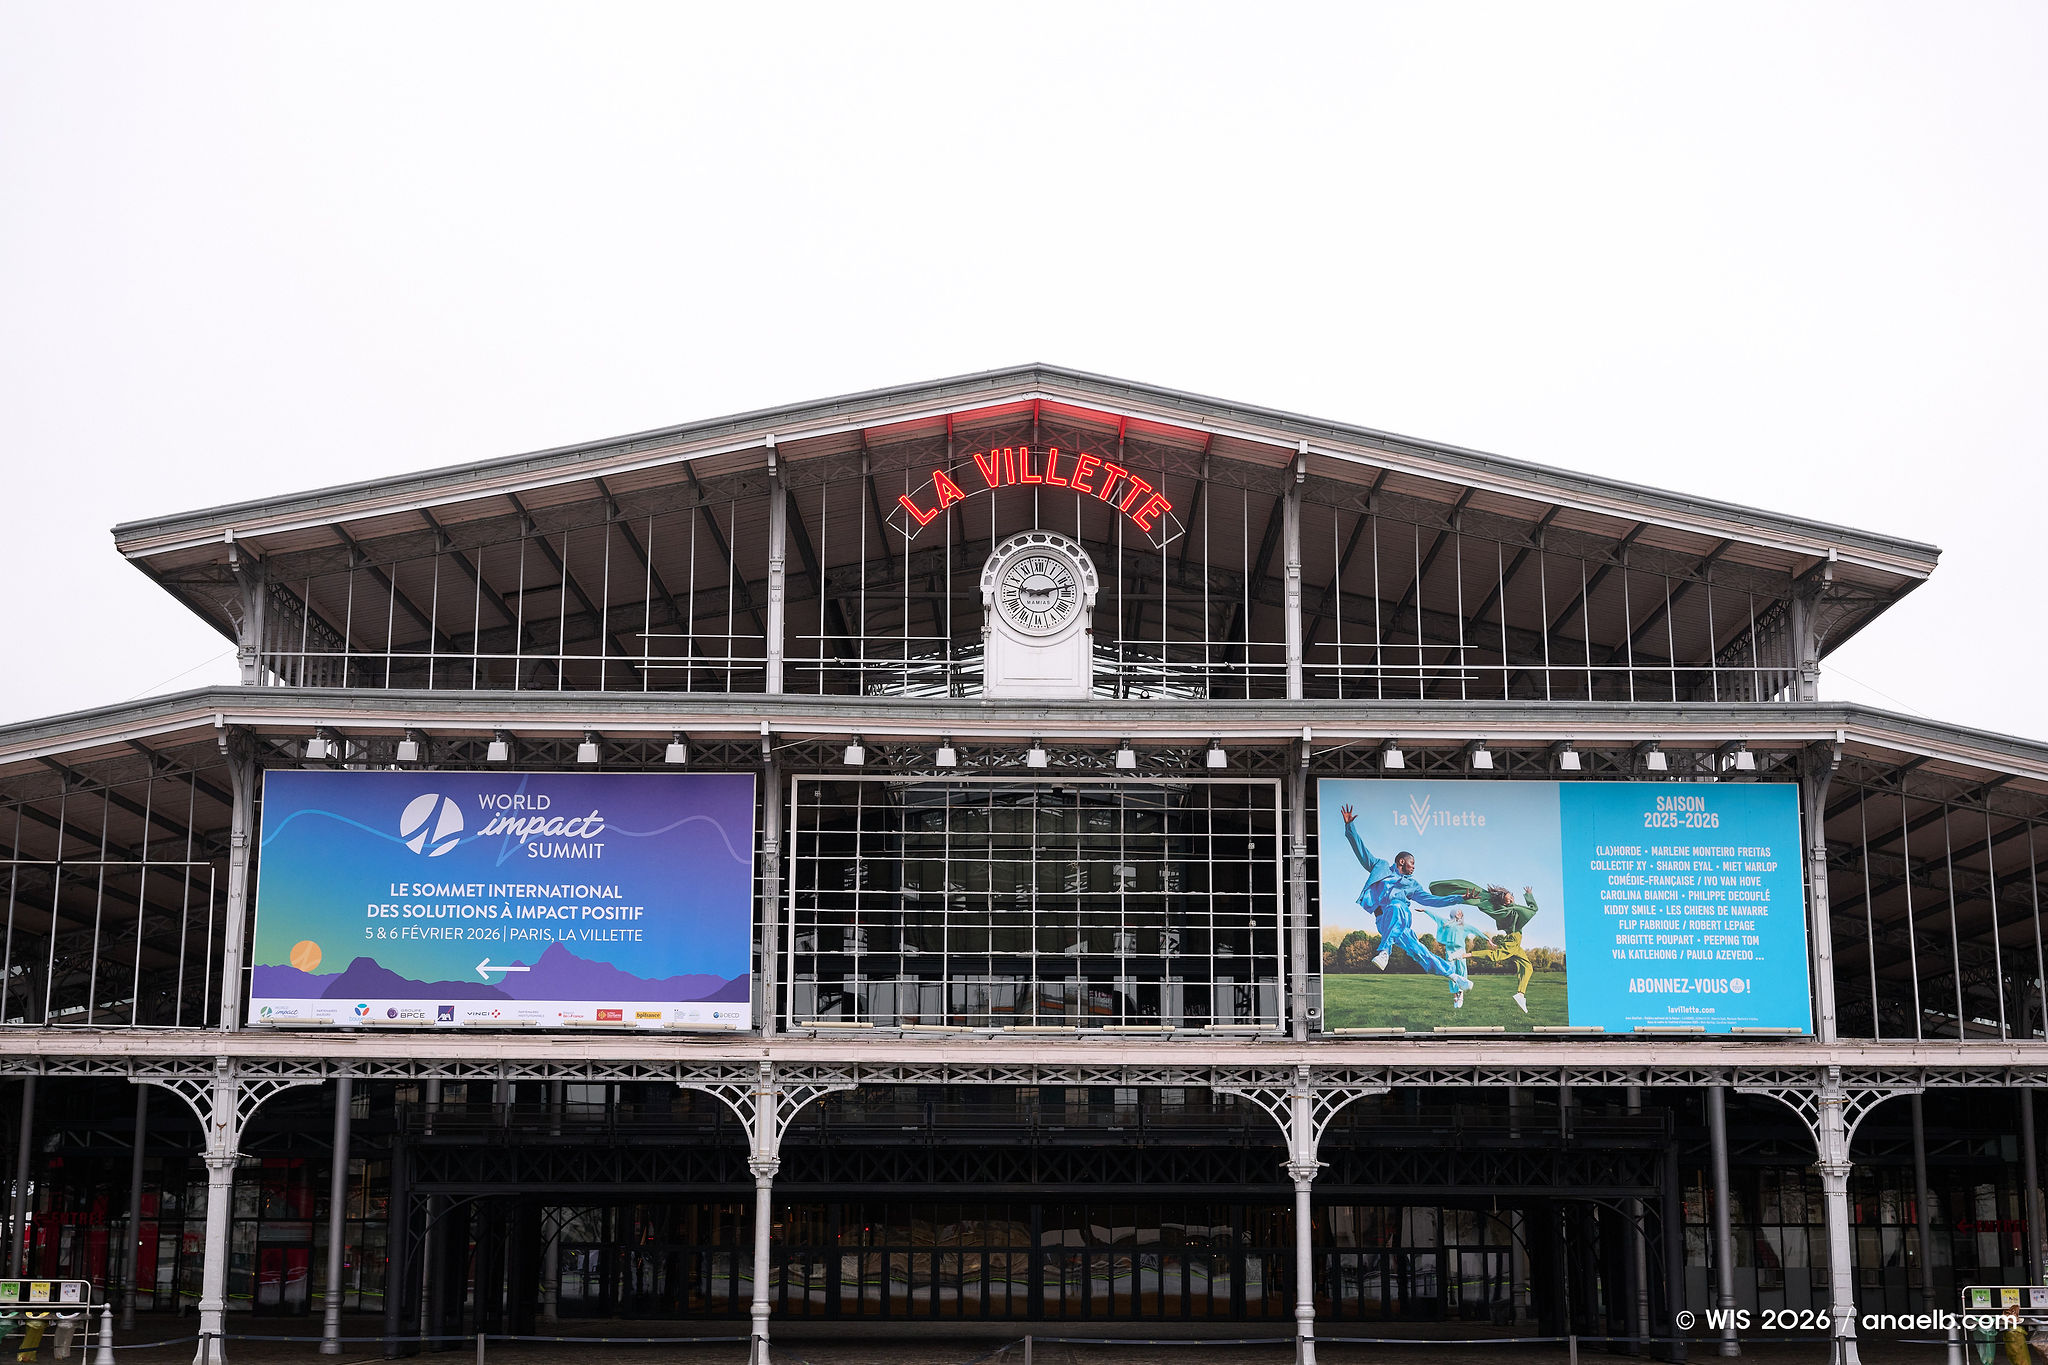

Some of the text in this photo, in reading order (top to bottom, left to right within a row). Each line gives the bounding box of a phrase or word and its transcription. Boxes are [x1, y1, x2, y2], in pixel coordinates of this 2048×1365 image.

[898, 446, 1173, 532] LA VILLETTE
[478, 794, 551, 810] WORLD
[1656, 795, 1706, 812] SAISON
[477, 809, 605, 844] impact
[1643, 811, 1720, 829] 2025-2026
[527, 842, 605, 859] SUMMIT
[1595, 845, 1771, 858] (LA)HORDE MARLENE MONTEIRO FREITAS
[1590, 860, 1778, 872] COLLECTIF XY SHARON EYAL MIET WARLOP
[1608, 872, 1695, 887] COMÉDIE-FRANÇAISE
[1703, 875, 1718, 887] IVO
[1719, 875, 1737, 887] VAN
[1739, 876, 1762, 887] HOVE
[390, 882, 623, 899] LE SOMMET INTERNATIONAL
[1600, 888, 1771, 902] CAROLINA BIANCHI PHILIPPE DECOUFLÉ
[367, 901, 644, 921] DES SOLUTIONS À IMPACT POSITIF
[1604, 904, 1769, 916] KIDDY SMILE LES CHIENS DE NAVARRE
[1618, 919, 1638, 930] FLIP
[1639, 919, 1680, 931] FABRIQUE
[1689, 919, 1722, 931] ROBERT
[1724, 920, 1756, 931] LEPAGE
[365, 927, 374, 940] 5
[376, 926, 390, 940] &
[389, 927, 399, 940] 6
[401, 924, 464, 940] FÉVRIER
[466, 927, 501, 941] 2026
[509, 927, 555, 944] PARIS,
[558, 928, 577, 941] LA
[579, 928, 643, 942] VILLETTE
[1615, 934, 1760, 946] BRIGITTE POUPART PEEPING TOM
[1611, 949, 1626, 960] VIA
[1628, 949, 1678, 960] KATLEHONG
[1686, 949, 1714, 961] PAULO
[1715, 949, 1754, 961] AZEVEDO
[1628, 977, 1729, 994] ABONNEZ-VOUS
[1667, 1005, 1716, 1014] lavillette.com
